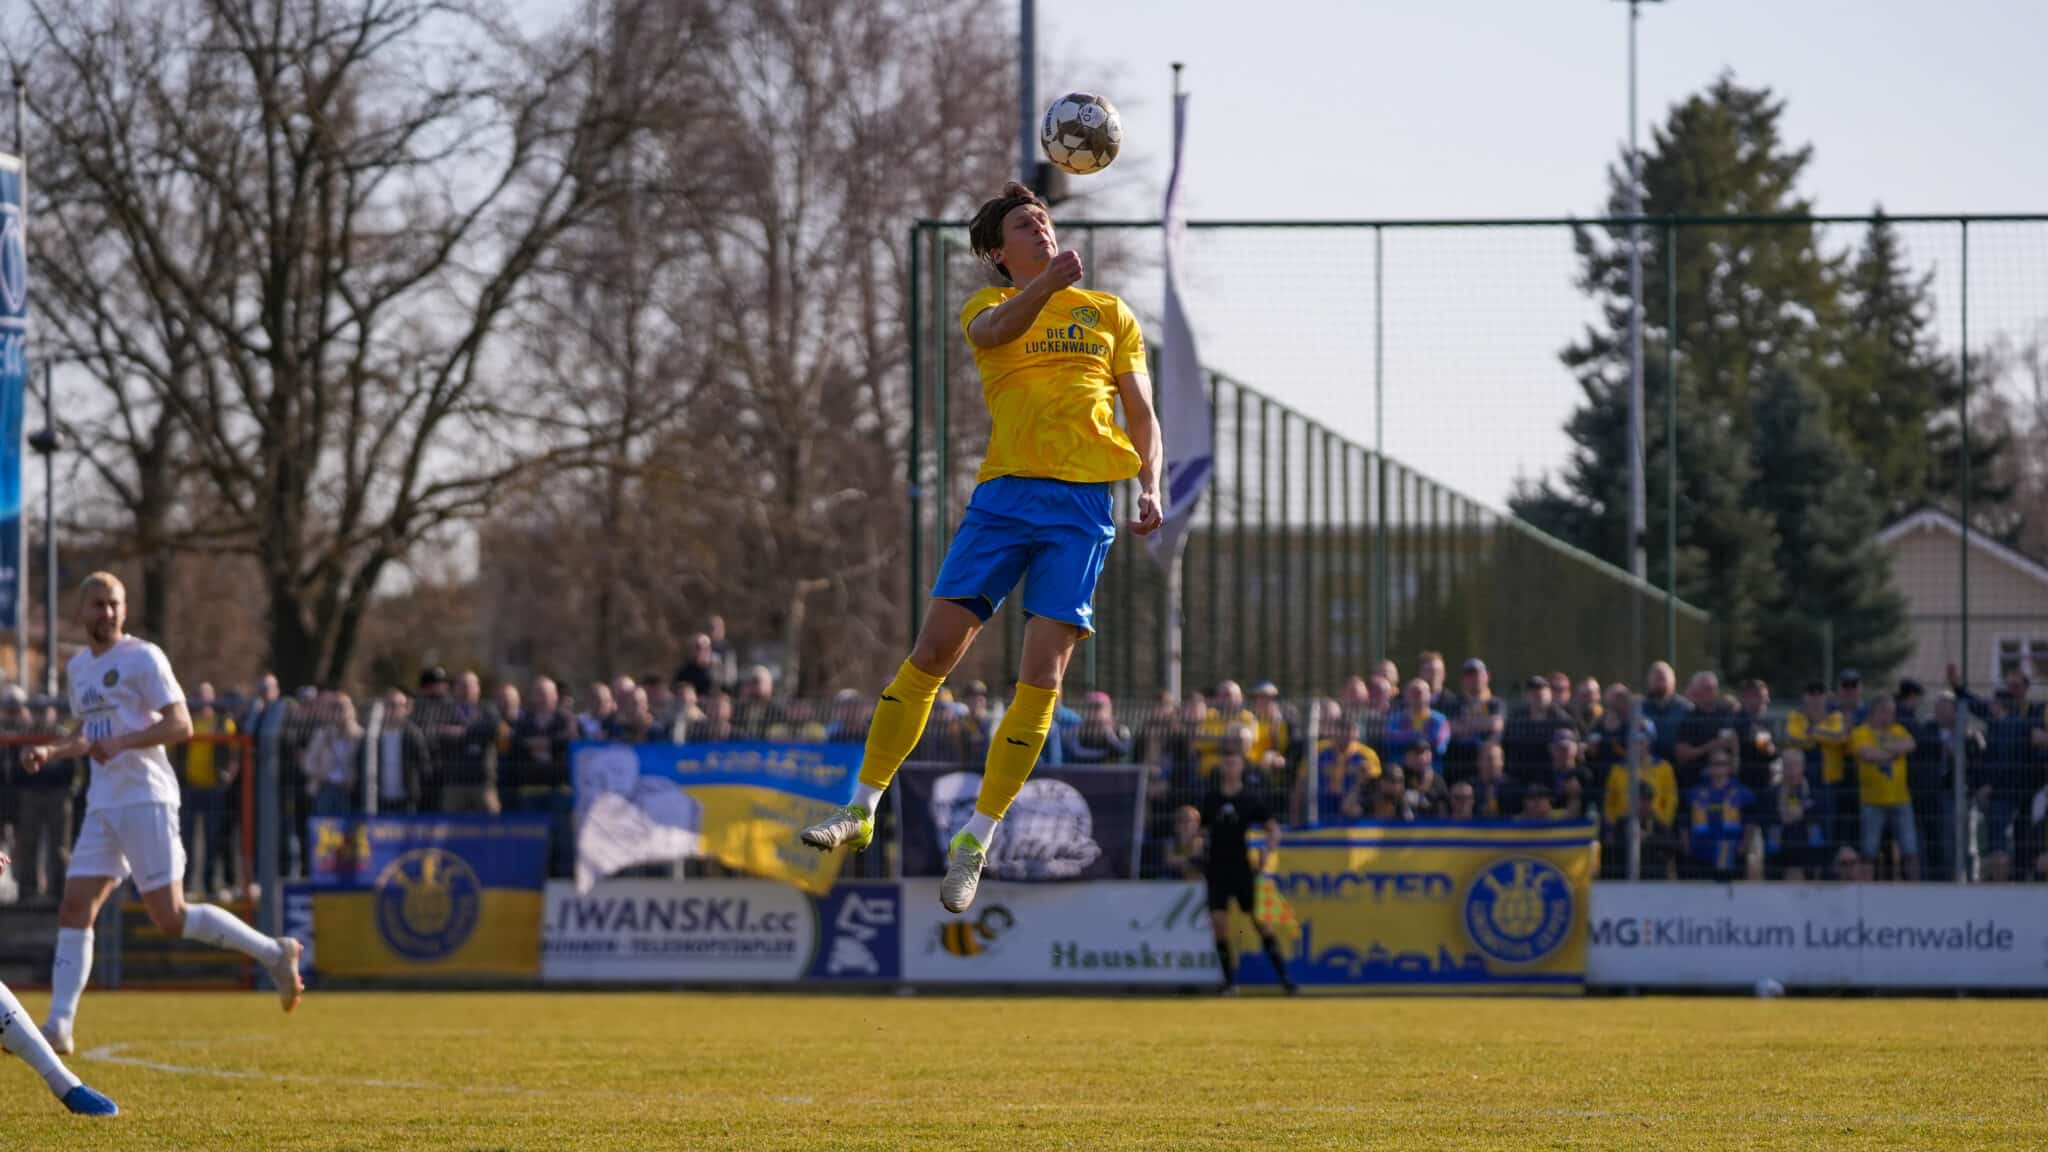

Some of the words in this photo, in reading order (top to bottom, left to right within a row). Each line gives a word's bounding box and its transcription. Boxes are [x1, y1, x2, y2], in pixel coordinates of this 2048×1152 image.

[1046, 327, 1065, 340] DIE
[1655, 915, 1796, 946] Klinikum
[1804, 917, 2015, 949] Luckenwalde
